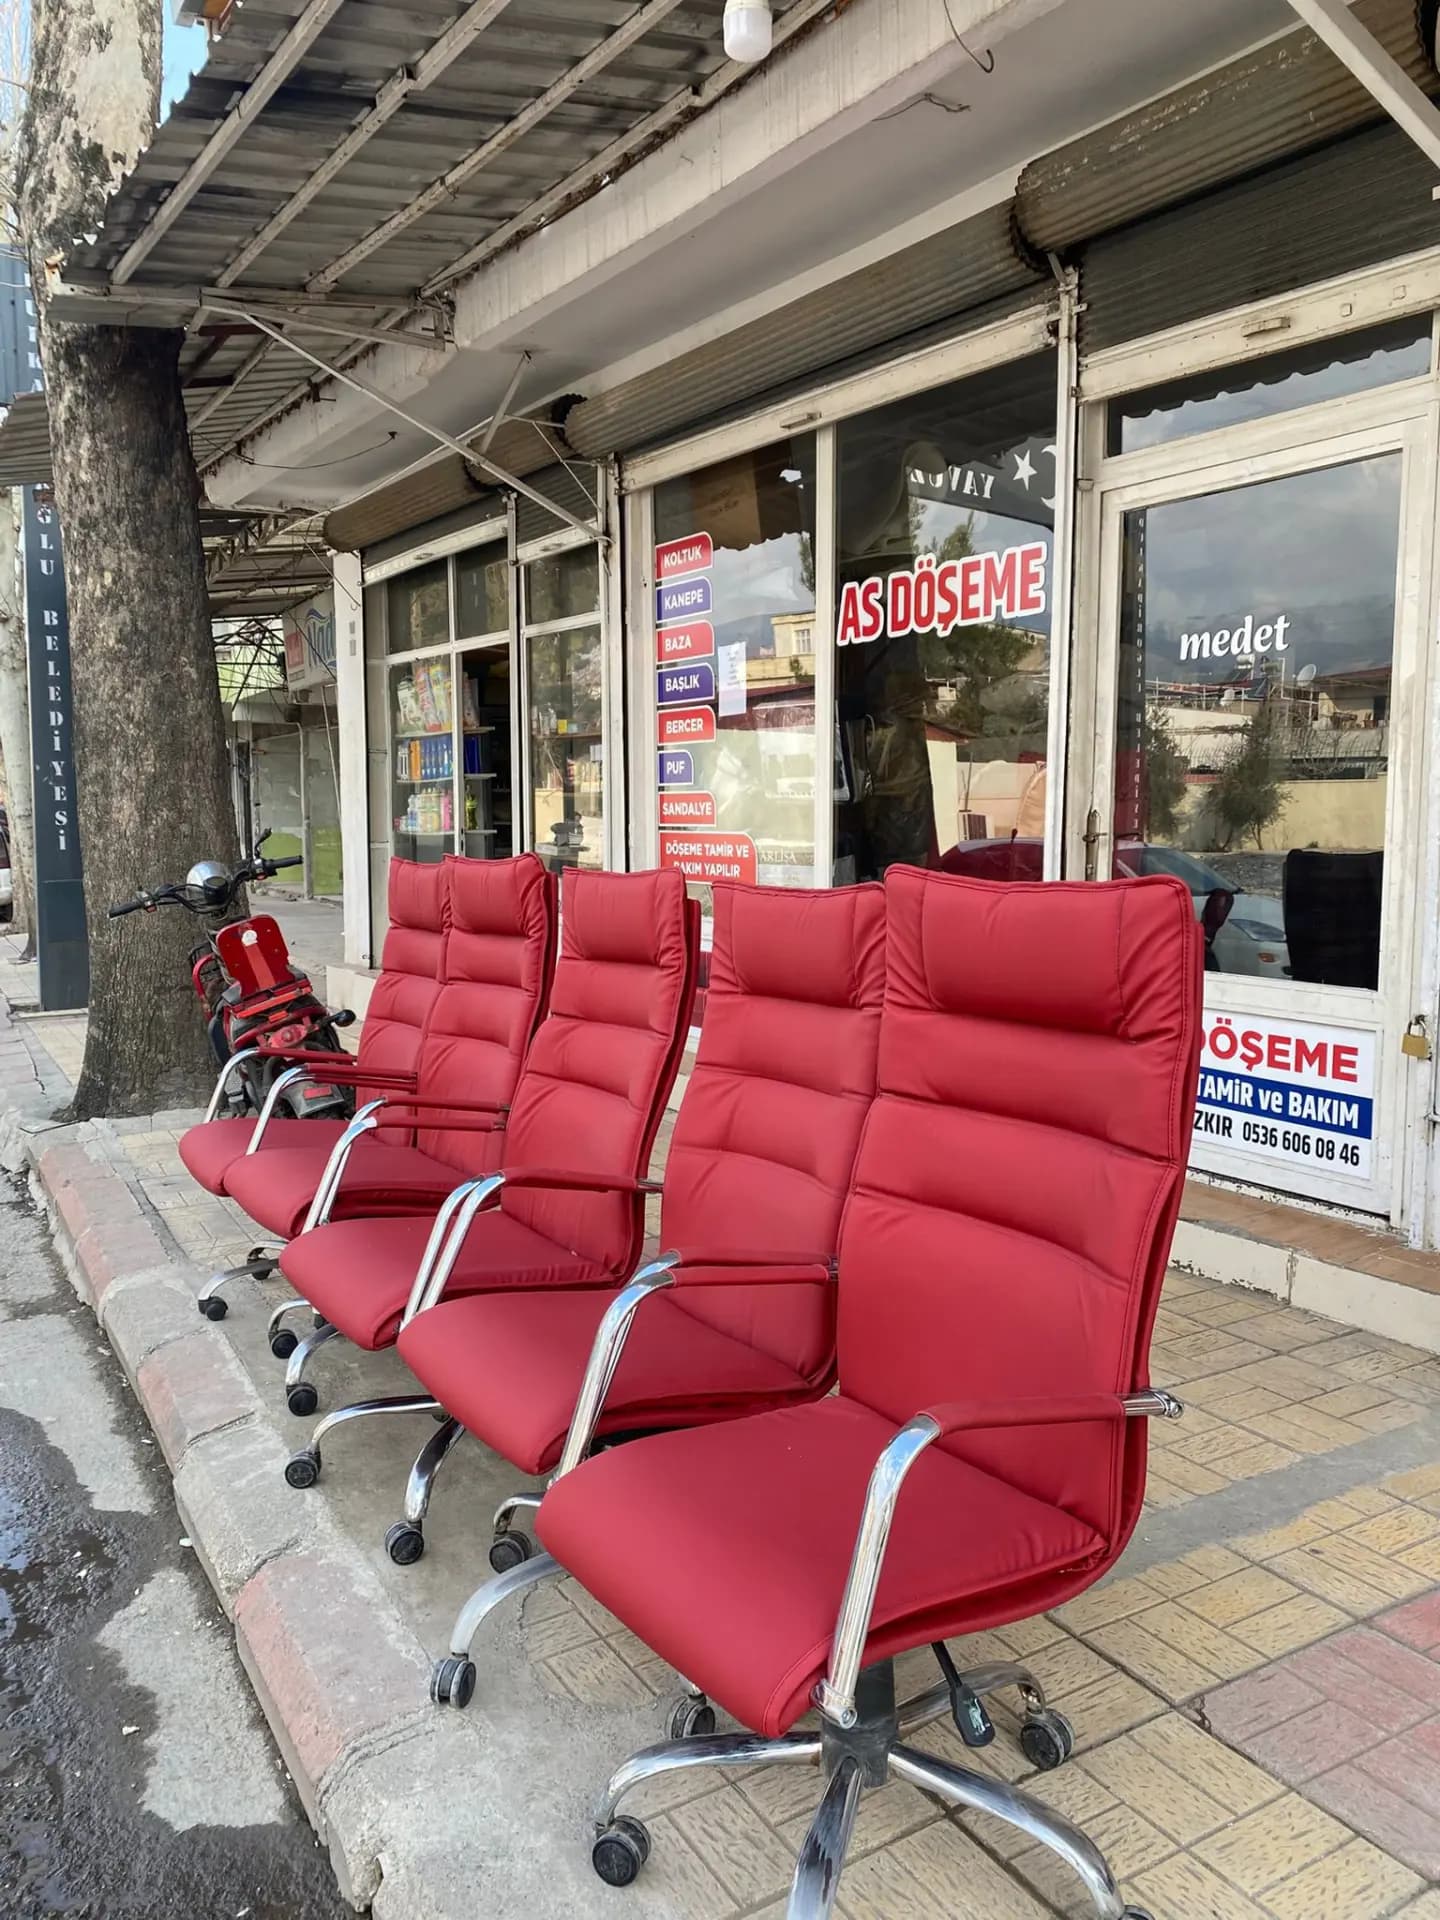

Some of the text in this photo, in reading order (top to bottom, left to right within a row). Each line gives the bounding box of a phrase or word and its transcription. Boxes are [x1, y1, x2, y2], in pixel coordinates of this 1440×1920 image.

[663, 545, 702, 569] KOLTUK
[664, 588, 704, 610] KANEPE
[839, 545, 1044, 643] AS DÖŞEME
[664, 634, 692, 652] BAZA
[1180, 614, 1290, 661] medet
[665, 674, 700, 692] BAŞLIK
[43, 610, 68, 850] BELEDİYESİ
[666, 718, 704, 734] BERCER
[666, 761, 685, 775] PUF
[662, 802, 712, 816] SANDALYE
[665, 840, 750, 858] DÖŞEME TAMİR VE
[704, 862, 741, 877] YAPILIR
[1197, 1073, 1359, 1129] TAMİR ve BAKIM
[1243, 1121, 1278, 1148] 0536
[1282, 1130, 1310, 1156] 606
[1316, 1137, 1335, 1160] 08
[1340, 1144, 1360, 1166] 46
